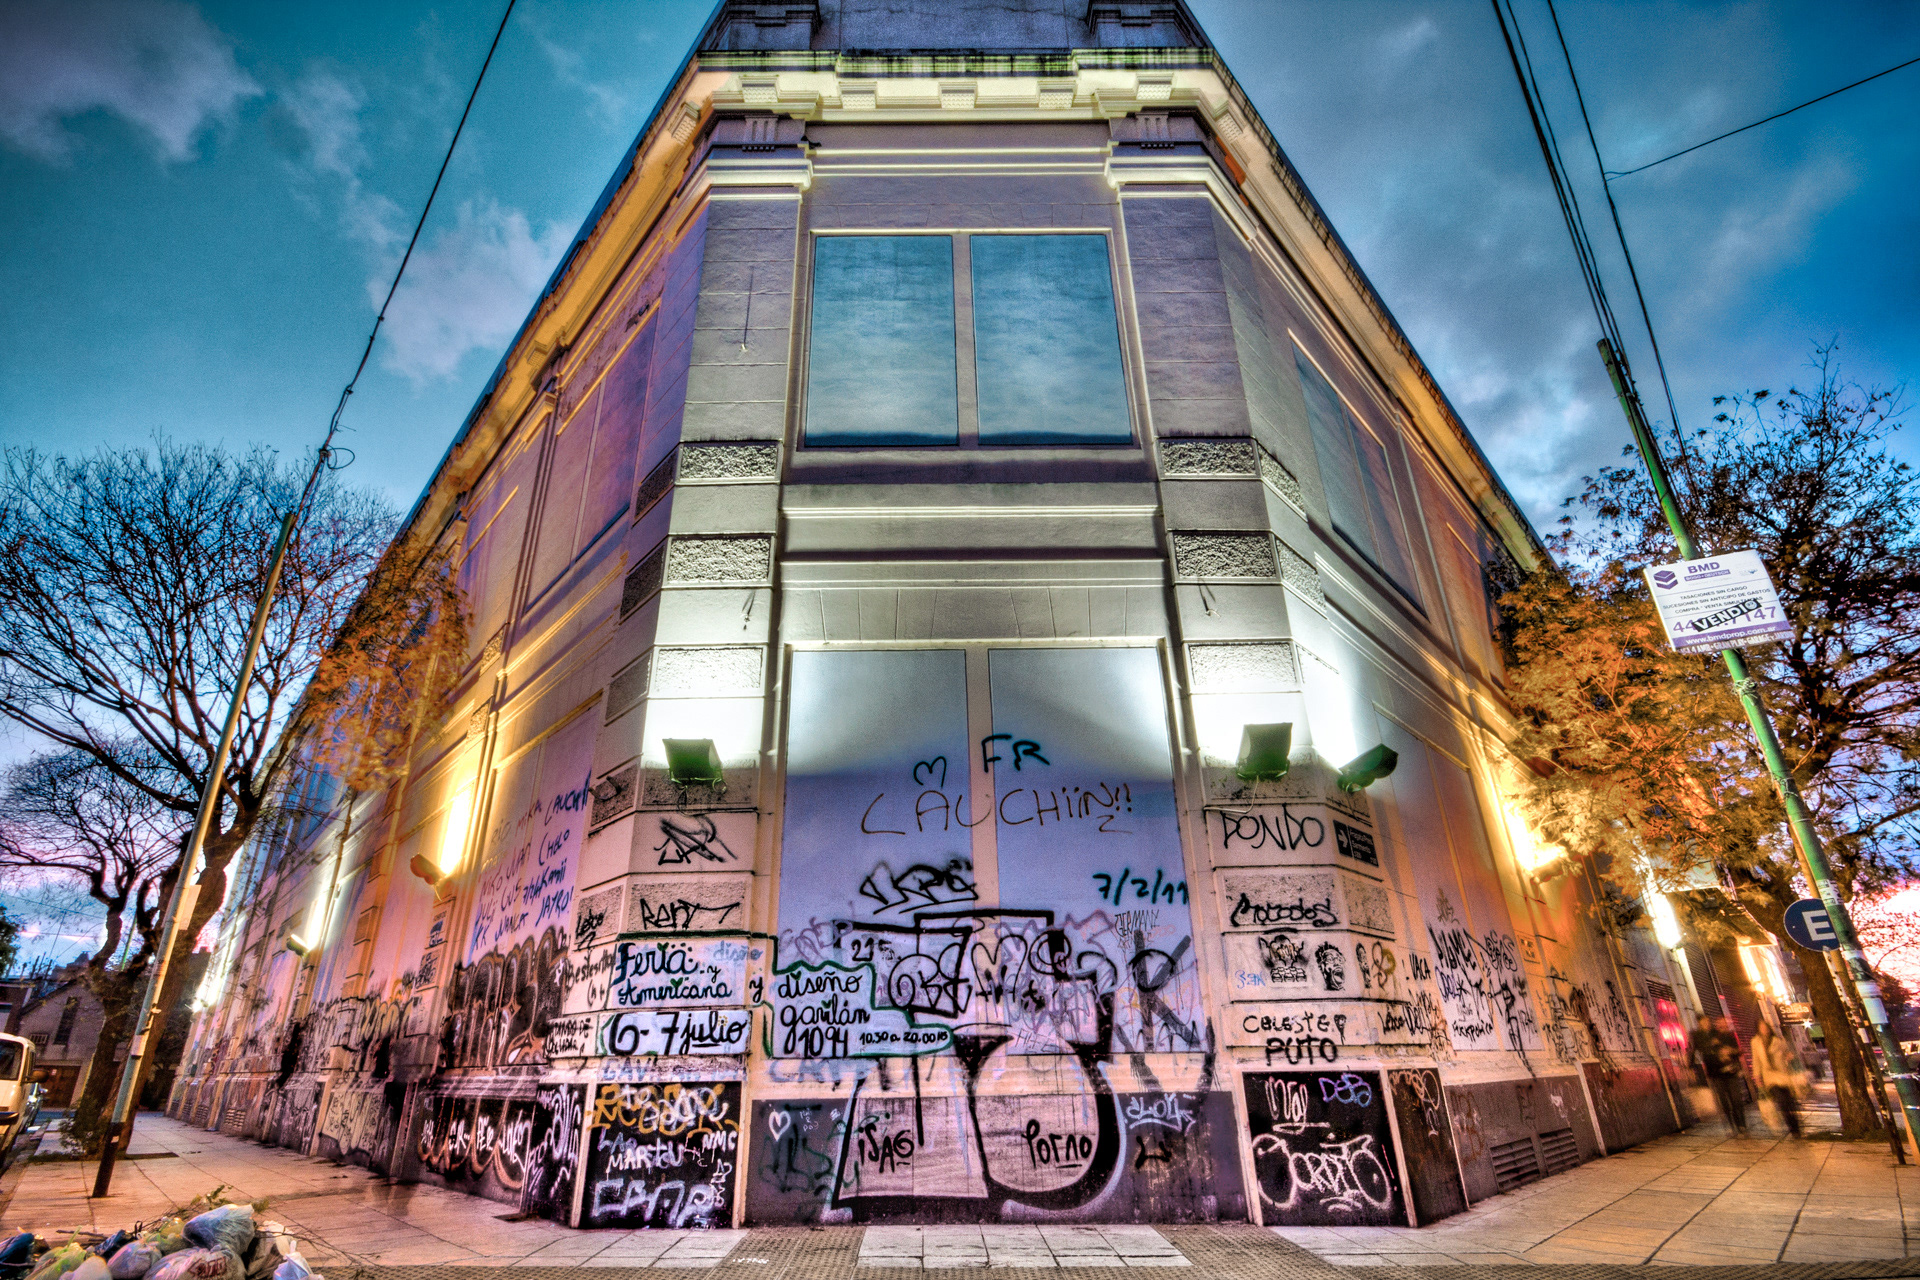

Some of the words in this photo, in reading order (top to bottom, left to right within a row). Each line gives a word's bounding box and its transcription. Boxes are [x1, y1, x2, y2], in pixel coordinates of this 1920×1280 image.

[1687, 562, 1720, 574] BMD
[1727, 585, 1747, 593] CARGO
[1747, 588, 1771, 596] GASTOS
[1703, 602, 1723, 610] VENTA
[1801, 909, 1837, 941] E
[612, 942, 699, 986] Feria
[707, 965, 722, 984] y
[618, 978, 733, 1006] Americana
[749, 976, 764, 1003] y
[778, 971, 863, 999] diseño
[1780, 1004, 1810, 1014] Salida
[680, 1011, 748, 1056] julio
[798, 1026, 848, 1058] 1094
[859, 1031, 889, 1046] 10.30
[890, 1034, 900, 1042] a
[903, 1031, 936, 1044] 20.00
[1265, 1034, 1338, 1066] PUTO
